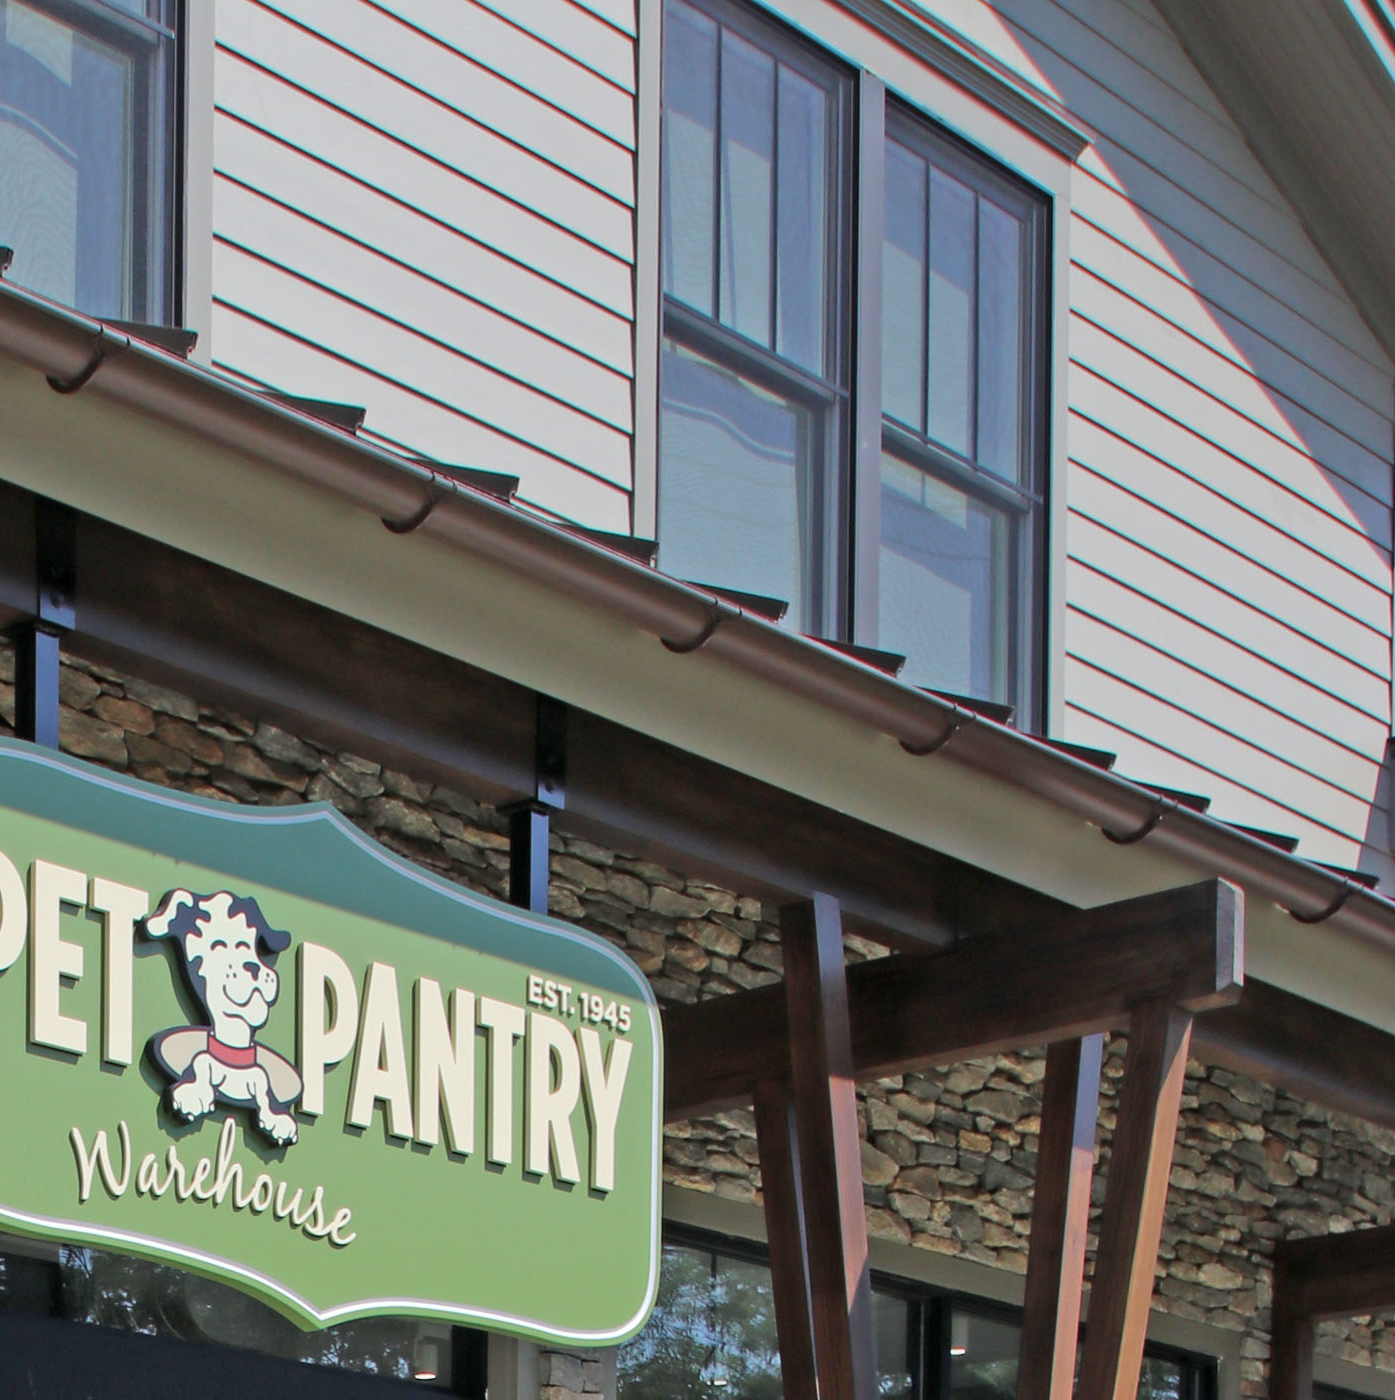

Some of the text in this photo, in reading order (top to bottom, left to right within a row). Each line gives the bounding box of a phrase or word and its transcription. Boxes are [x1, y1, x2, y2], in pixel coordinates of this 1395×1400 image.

[296, 941, 633, 1193] PANTRY
[528, 974, 633, 1033] EST. 1945
[70, 1119, 357, 1247] Warehouse
